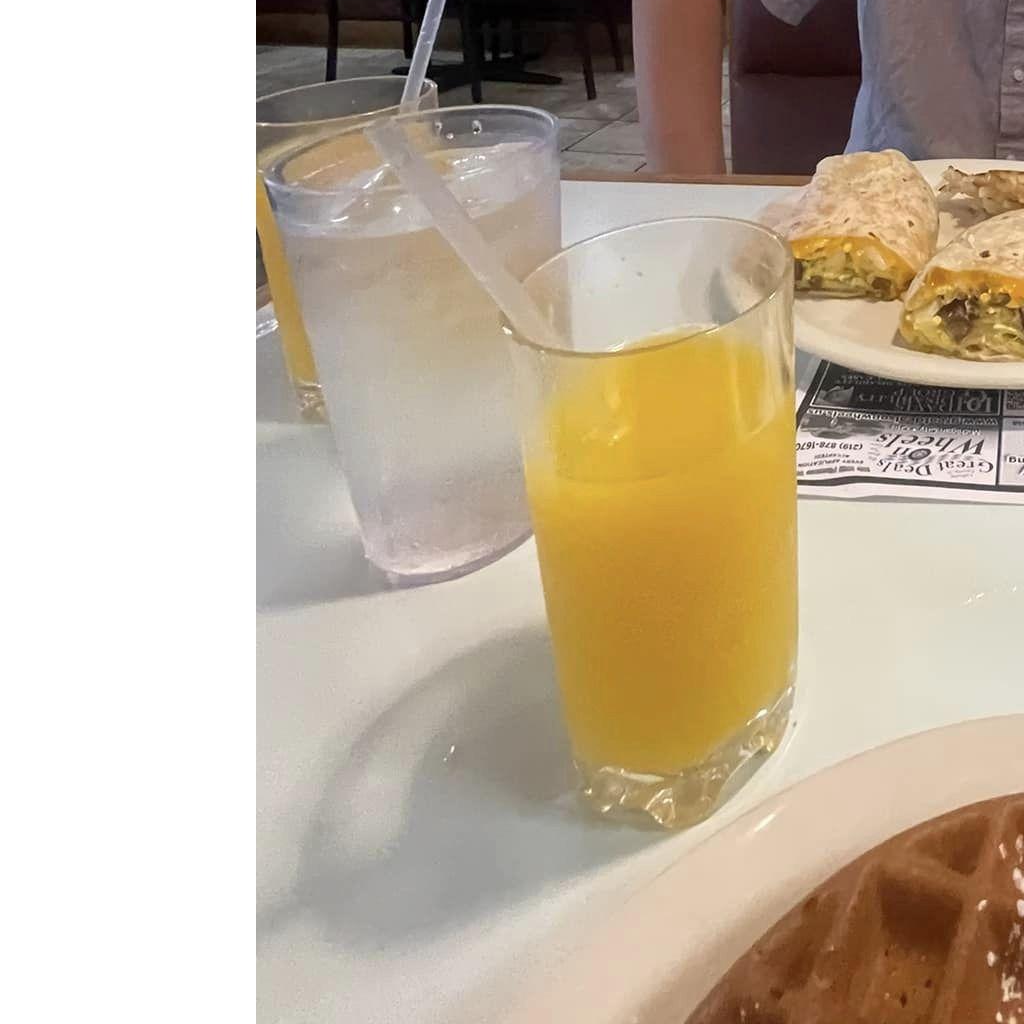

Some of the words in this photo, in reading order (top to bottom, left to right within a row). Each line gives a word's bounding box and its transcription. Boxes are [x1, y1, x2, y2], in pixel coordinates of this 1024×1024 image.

[838, 442, 863, 451] (219)
[876, 433, 985, 455] Wheels
[876, 459, 933, 477] Deals
[938, 458, 994, 474] Great
